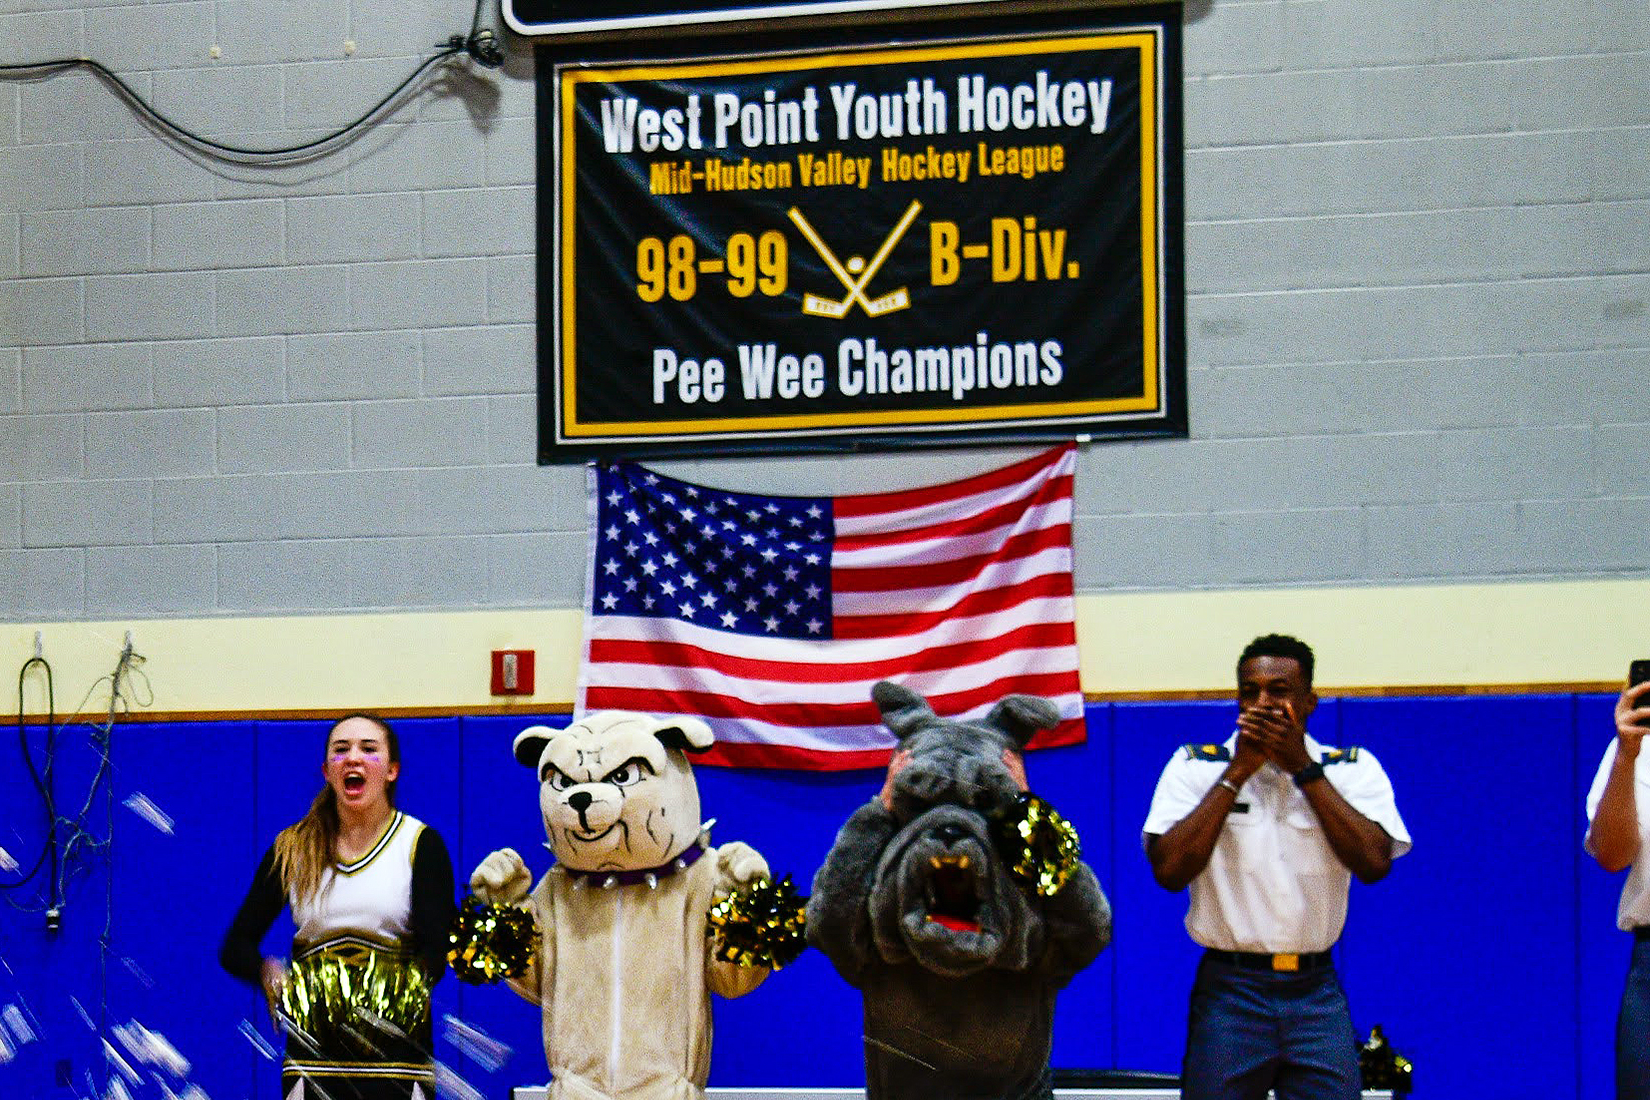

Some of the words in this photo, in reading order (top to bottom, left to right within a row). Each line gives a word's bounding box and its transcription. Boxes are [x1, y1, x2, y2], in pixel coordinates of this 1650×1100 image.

[600, 94, 703, 154] West
[714, 88, 820, 149] Point
[829, 78, 948, 141] Youth
[957, 69, 1113, 135] Hockey
[649, 157, 792, 196] Mid-Hudson
[798, 149, 872, 190] Valley
[881, 144, 971, 183] Hockey
[977, 140, 1065, 180] League
[636, 229, 789, 303] 98-99
[929, 215, 1080, 287] B-Div.
[652, 347, 725, 404] Pee
[738, 342, 825, 399] Wee
[838, 330, 1064, 400] Champions
